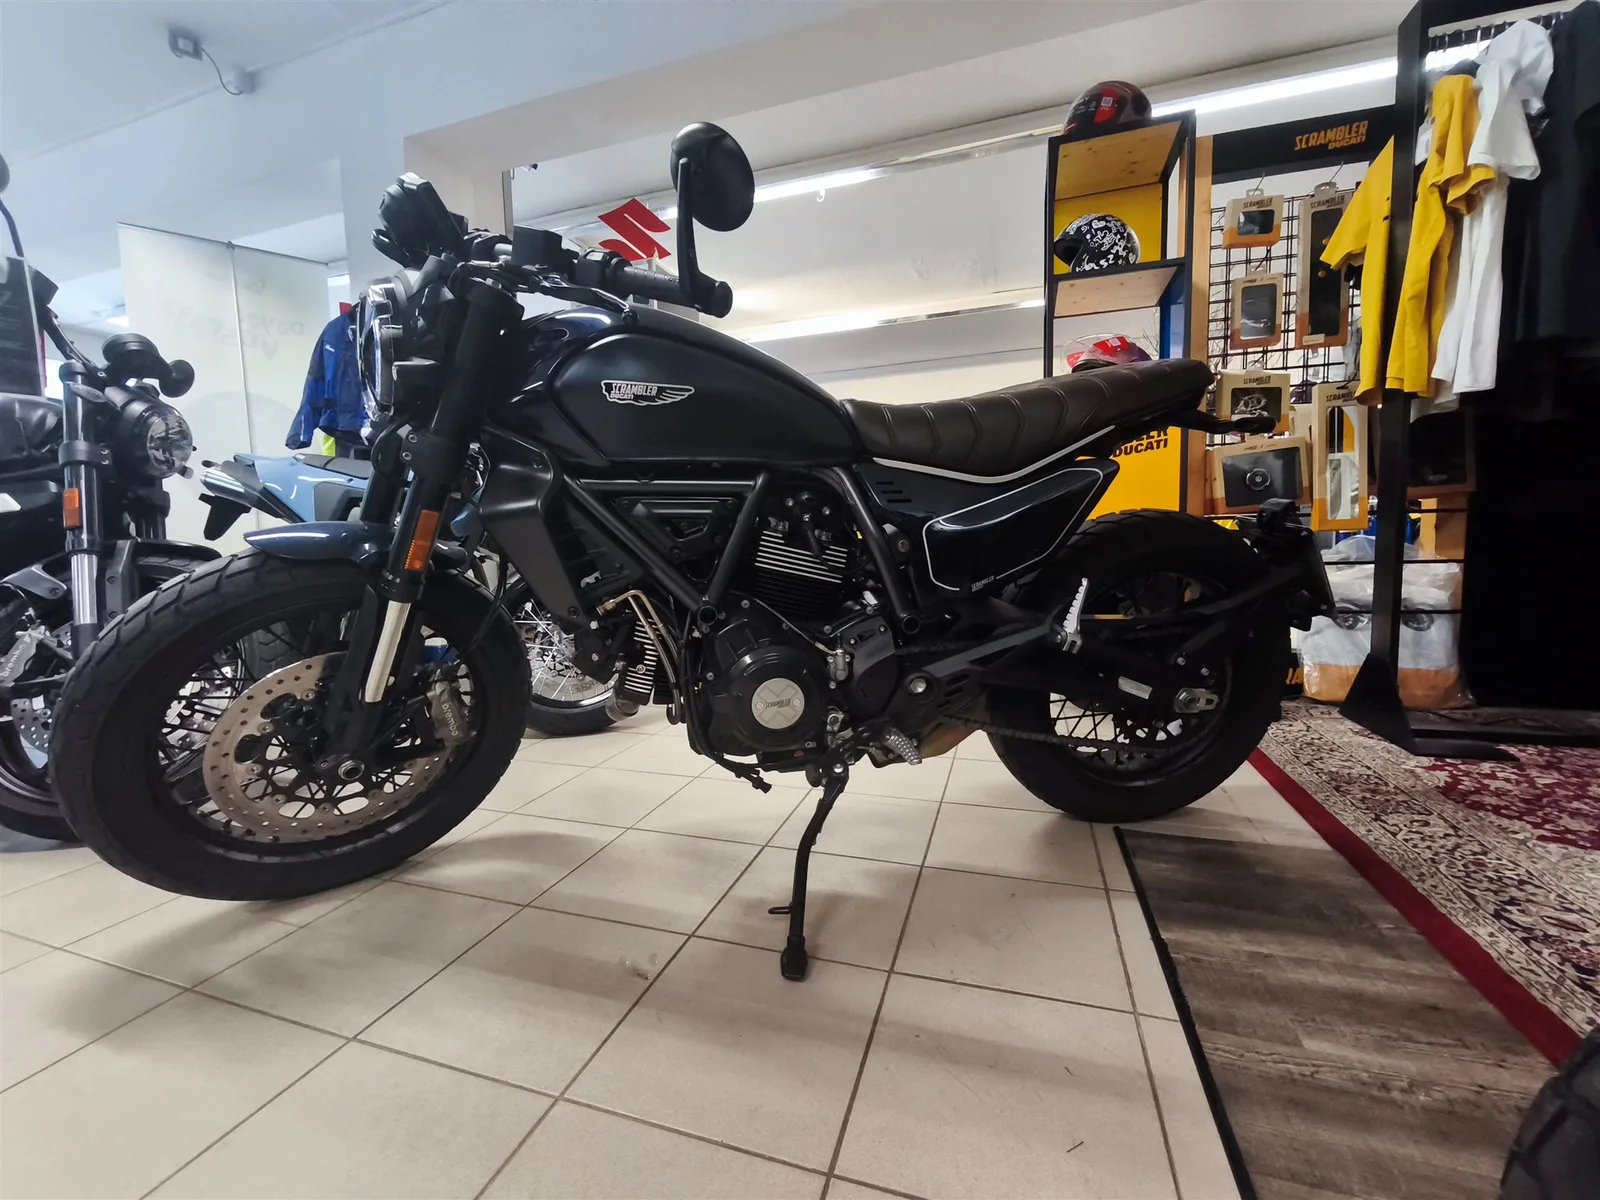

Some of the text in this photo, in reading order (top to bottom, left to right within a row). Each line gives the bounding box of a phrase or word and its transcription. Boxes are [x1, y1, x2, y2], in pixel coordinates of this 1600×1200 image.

[1294, 120, 1369, 151] SCRAMBLER
[1328, 135, 1366, 150] DUCATI
[611, 383, 658, 396] SCRAMBLER
[1112, 438, 1168, 458] DUCATI
[442, 702, 459, 736] brembo
